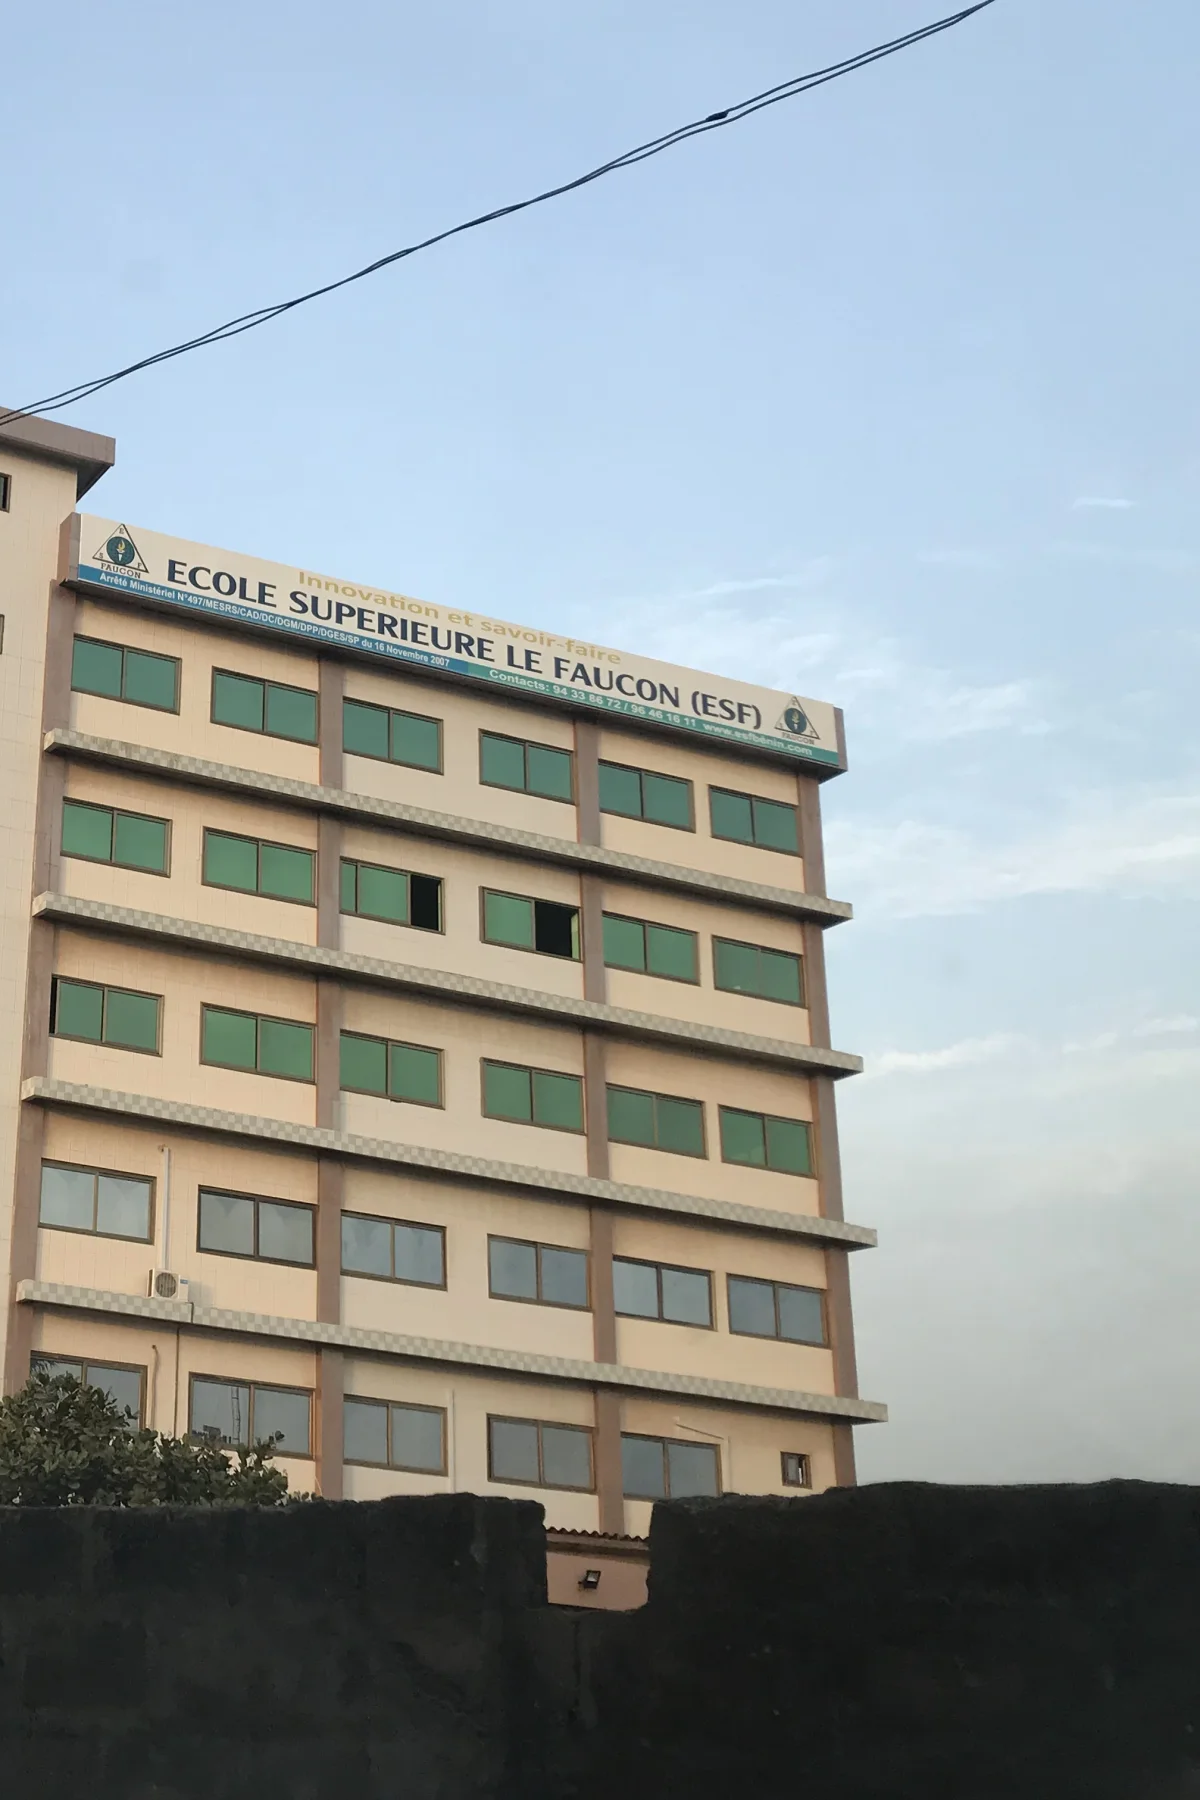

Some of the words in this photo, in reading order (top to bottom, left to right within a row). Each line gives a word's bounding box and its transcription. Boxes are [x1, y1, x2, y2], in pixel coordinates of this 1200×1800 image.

[100, 562, 141, 579] FAUCON
[99, 572, 128, 588] Arrêté
[129, 579, 175, 599] Ministériel
[361, 638, 373, 649] du
[374, 642, 384, 651] 16
[386, 644, 429, 663] Novembre
[430, 655, 450, 667] 2007
[167, 559, 277, 608] ECOLE
[289, 590, 495, 662] SUPERIEURE
[507, 644, 543, 674] LE
[553, 656, 680, 708] FAUCON
[691, 690, 762, 730] (ESF)
[299, 571, 439, 620] Innovation
[447, 611, 473, 628] et
[480, 621, 621, 665] savoir-faire
[489, 668, 551, 692] Contacts:
[552, 684, 568, 696] 94
[570, 689, 586, 700] 33
[606, 697, 621, 709] 72
[683, 717, 696, 727] 11
